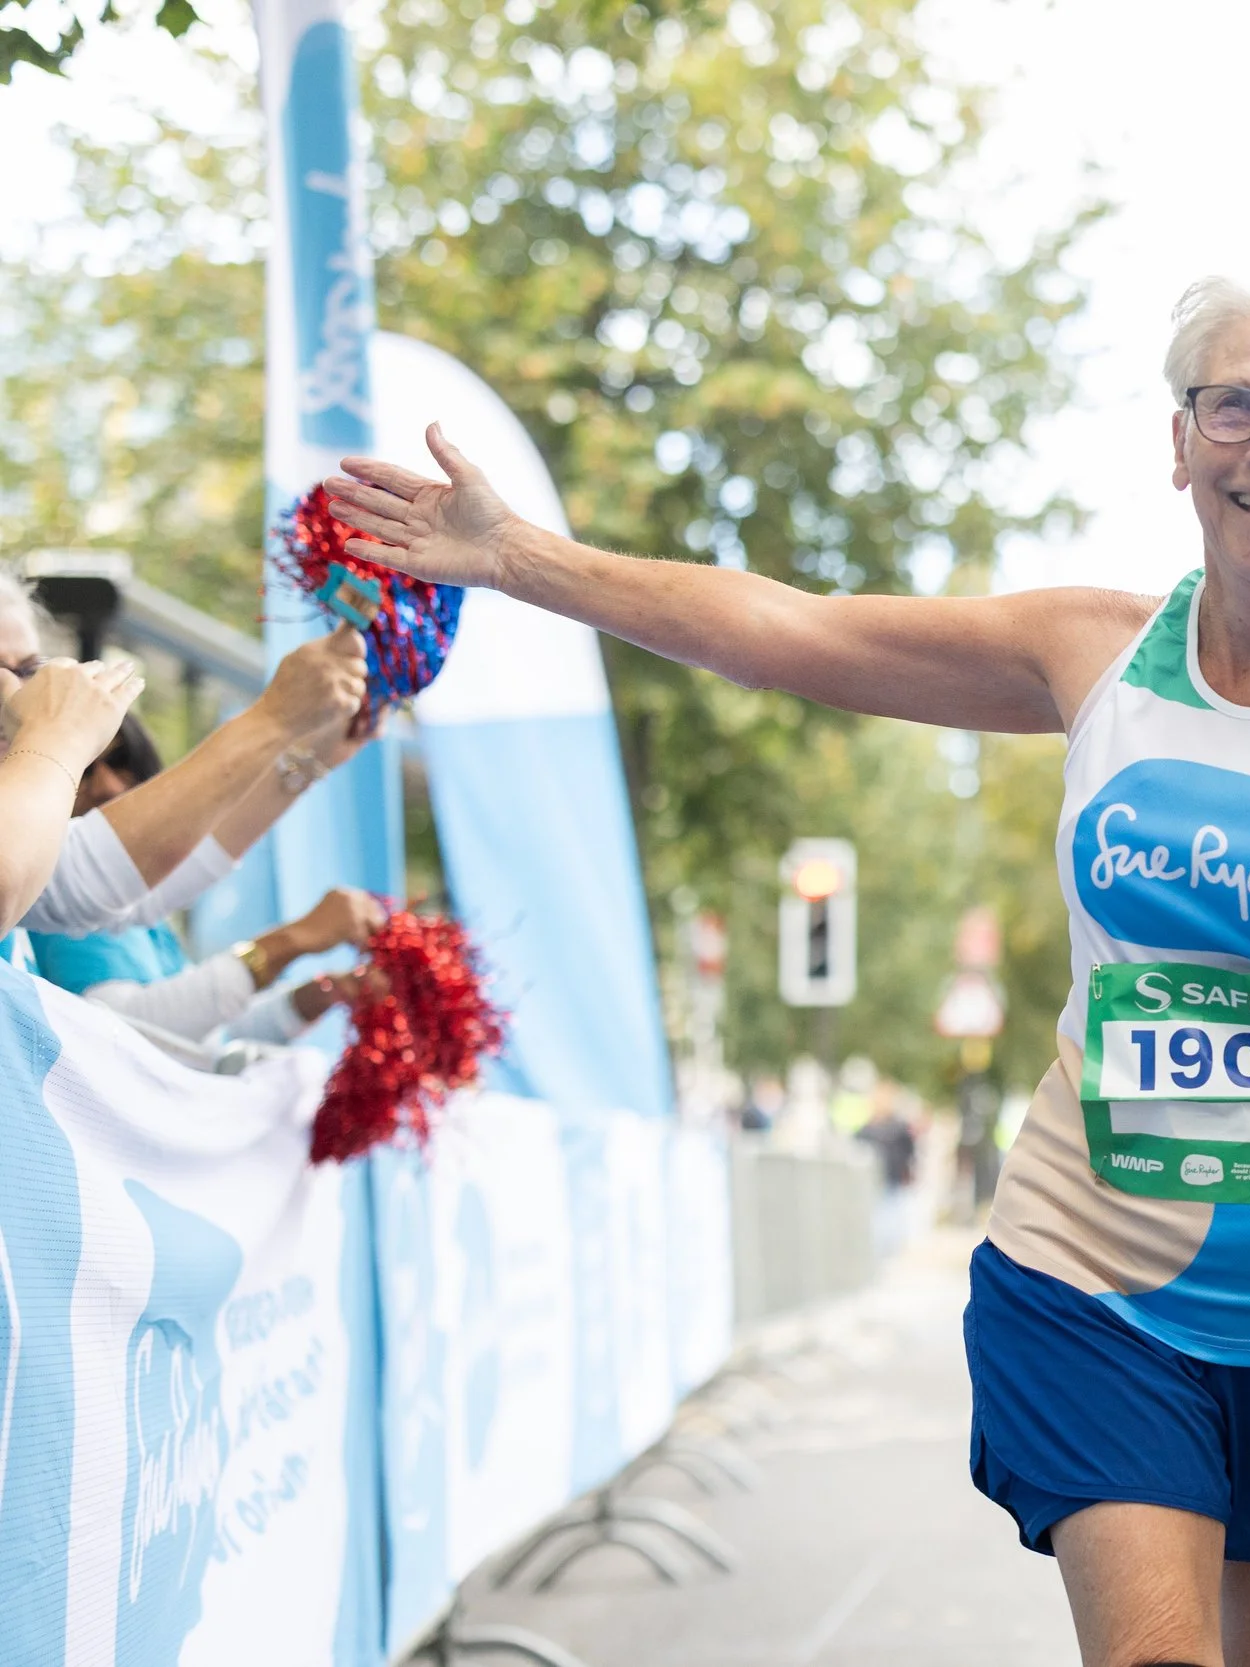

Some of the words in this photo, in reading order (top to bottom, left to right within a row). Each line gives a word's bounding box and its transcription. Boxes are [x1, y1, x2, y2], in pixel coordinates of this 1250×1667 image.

[1090, 802, 1186, 890] Sue
[1111, 1153, 1164, 1173] WMP
[1184, 1162, 1198, 1176] Sue
[1198, 1164, 1220, 1178] Ryder
